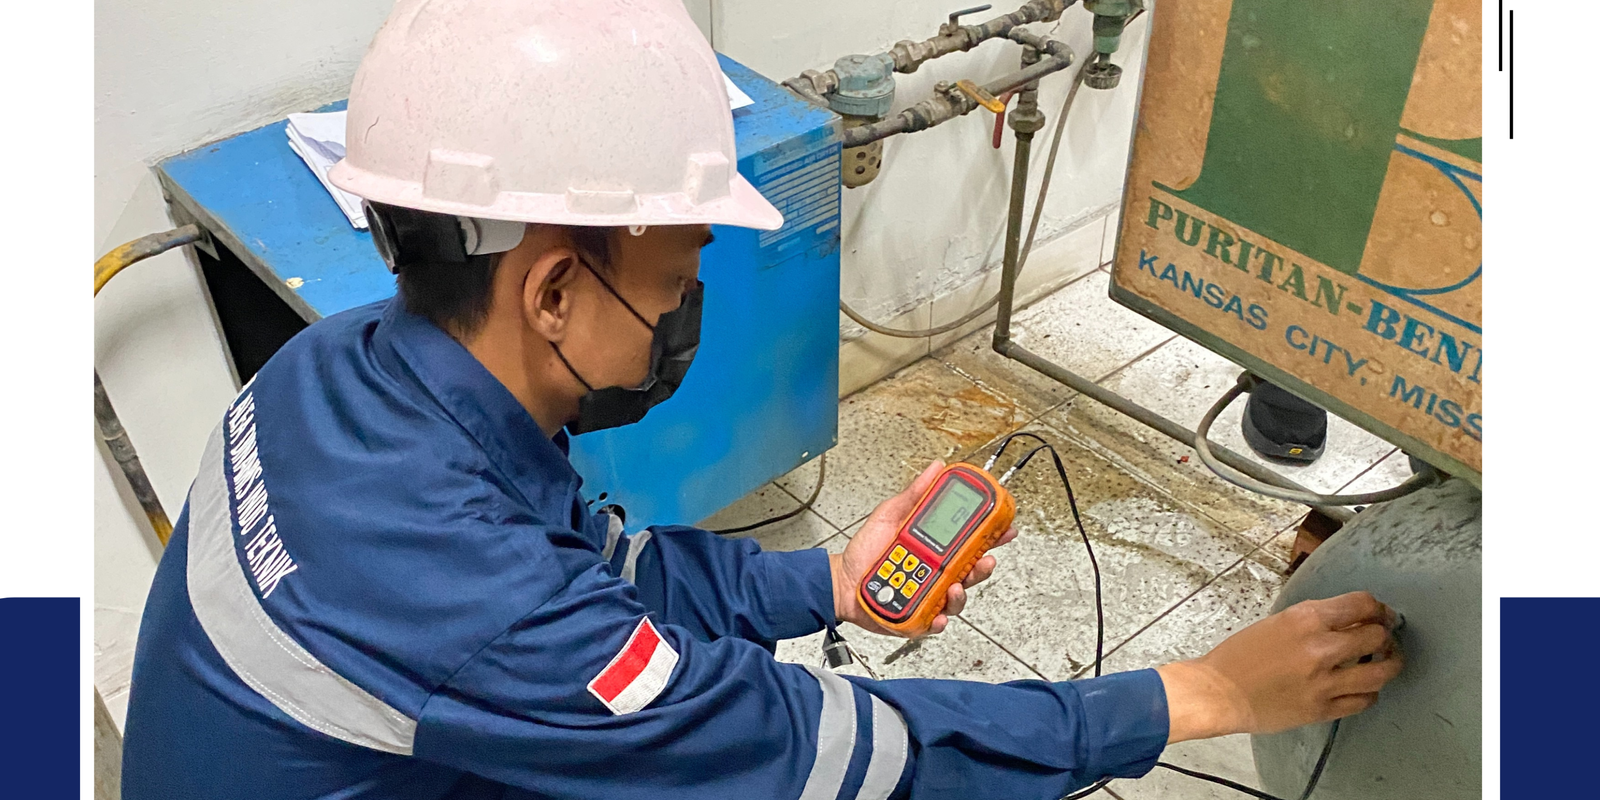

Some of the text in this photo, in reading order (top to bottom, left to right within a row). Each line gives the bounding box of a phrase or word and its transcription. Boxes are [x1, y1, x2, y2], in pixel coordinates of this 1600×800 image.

[1138, 250, 1482, 443] KANSAS CITY, MISS
[237, 479, 268, 535] INDO
[244, 514, 298, 599] TEKNIK
